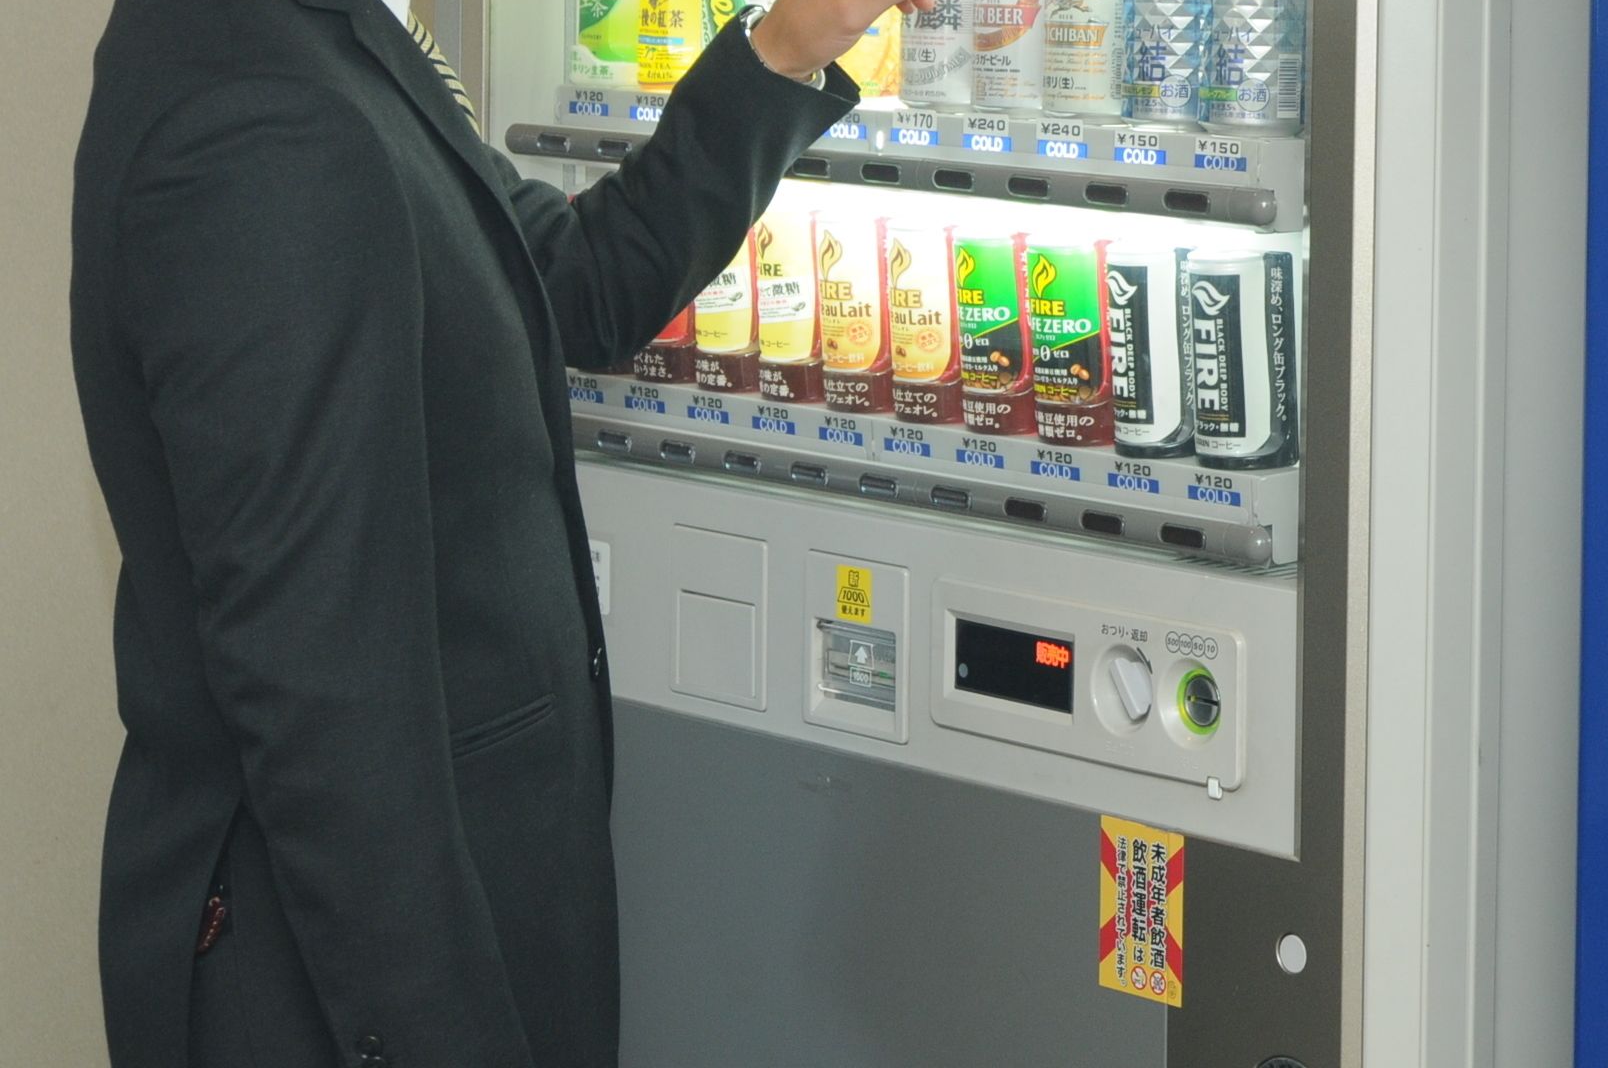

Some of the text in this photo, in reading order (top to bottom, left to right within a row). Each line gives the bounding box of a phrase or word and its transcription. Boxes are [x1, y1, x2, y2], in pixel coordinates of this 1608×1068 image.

[576, 90, 603, 102] ¥120
[1160, 84, 1188, 99] お酒
[1239, 89, 1267, 104] お酒
[968, 118, 1005, 131] ¥240
[1042, 123, 1080, 136] ¥240
[1118, 134, 1157, 147] ¥150
[1123, 149, 1156, 164] COLD
[970, 307, 1010, 322] ZERO
[1030, 300, 1065, 316] FIRE
[1050, 318, 1092, 334] ZERO
[1269, 266, 1288, 421] 味深め、ロング缶ブラック。
[1109, 312, 1127, 398] FIRE
[1194, 318, 1219, 412] FIRE
[630, 385, 658, 398] ¥120
[825, 417, 855, 430] ¥120
[1037, 450, 1072, 464] ¥120
[1116, 477, 1149, 491] COLD
[842, 589, 866, 605] 1000
[1101, 623, 1148, 642] おつり・返却
[1036, 642, 1069, 669] 販売中
[1132, 839, 1148, 962] 飲酒運転は
[1150, 842, 1166, 968] 未成年者飲酒
[1116, 837, 1127, 987] 法律で禁止されています。
